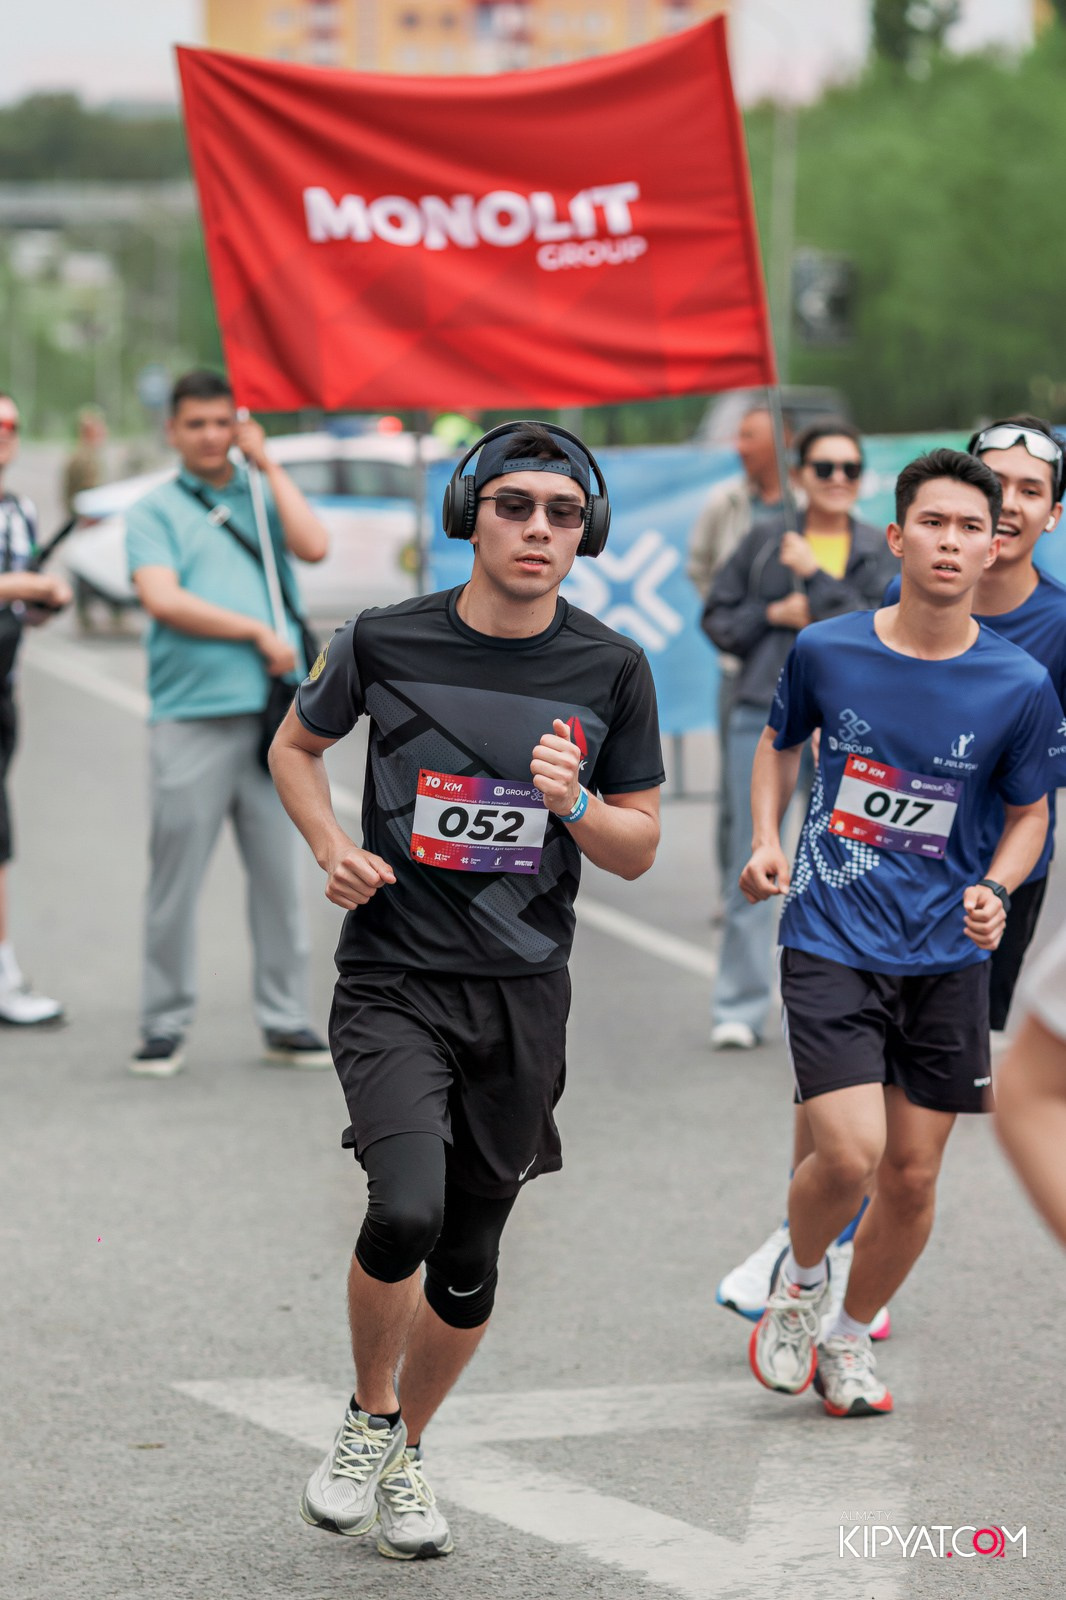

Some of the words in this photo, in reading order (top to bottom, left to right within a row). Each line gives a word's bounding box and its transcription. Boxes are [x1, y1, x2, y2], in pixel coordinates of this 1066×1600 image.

[303, 181, 640, 251] MONOLIT
[536, 235, 648, 271] GROUP
[839, 741, 874, 755] GROUP
[852, 759, 868, 772] 10
[868, 767, 886, 779] KM
[425, 775, 441, 788] 10
[443, 782, 463, 792] KM
[505, 788, 531, 796] GROUP
[863, 790, 935, 827] 017
[437, 806, 525, 843] 052
